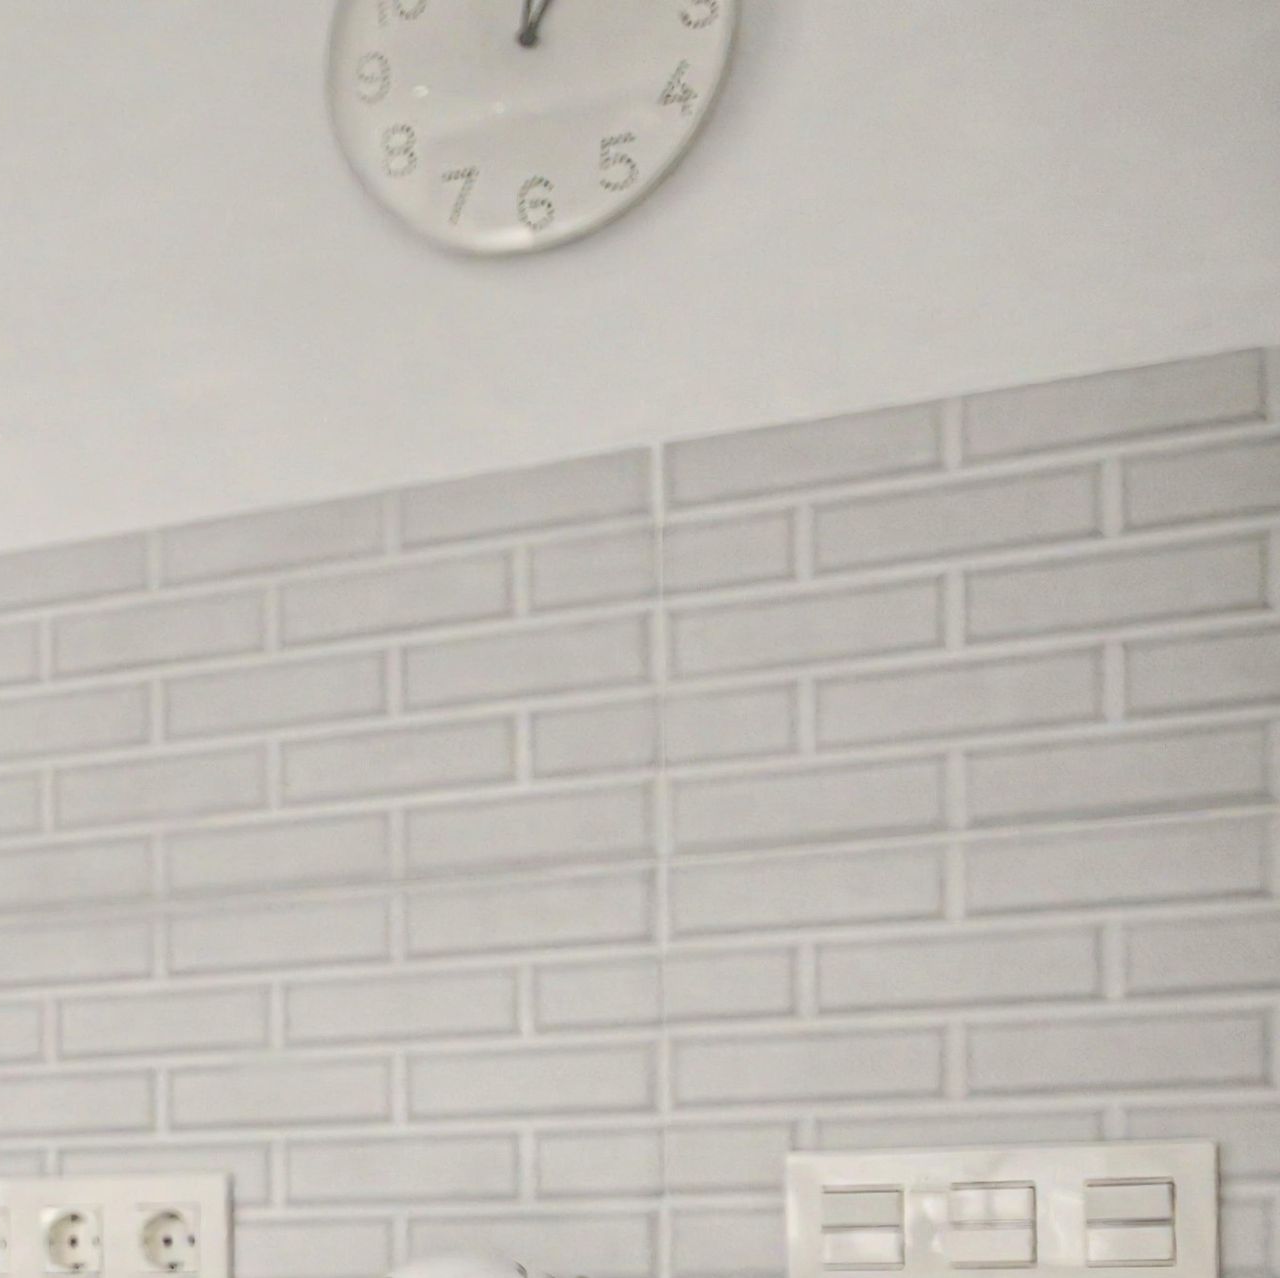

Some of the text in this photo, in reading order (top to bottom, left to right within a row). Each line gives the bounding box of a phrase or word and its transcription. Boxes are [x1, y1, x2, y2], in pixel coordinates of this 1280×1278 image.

[355, 51, 391, 103] 9
[657, 59, 699, 117] 4
[381, 123, 418, 178] 8
[599, 132, 638, 192] 5
[441, 164, 481, 225] 7
[517, 175, 555, 230] 6
